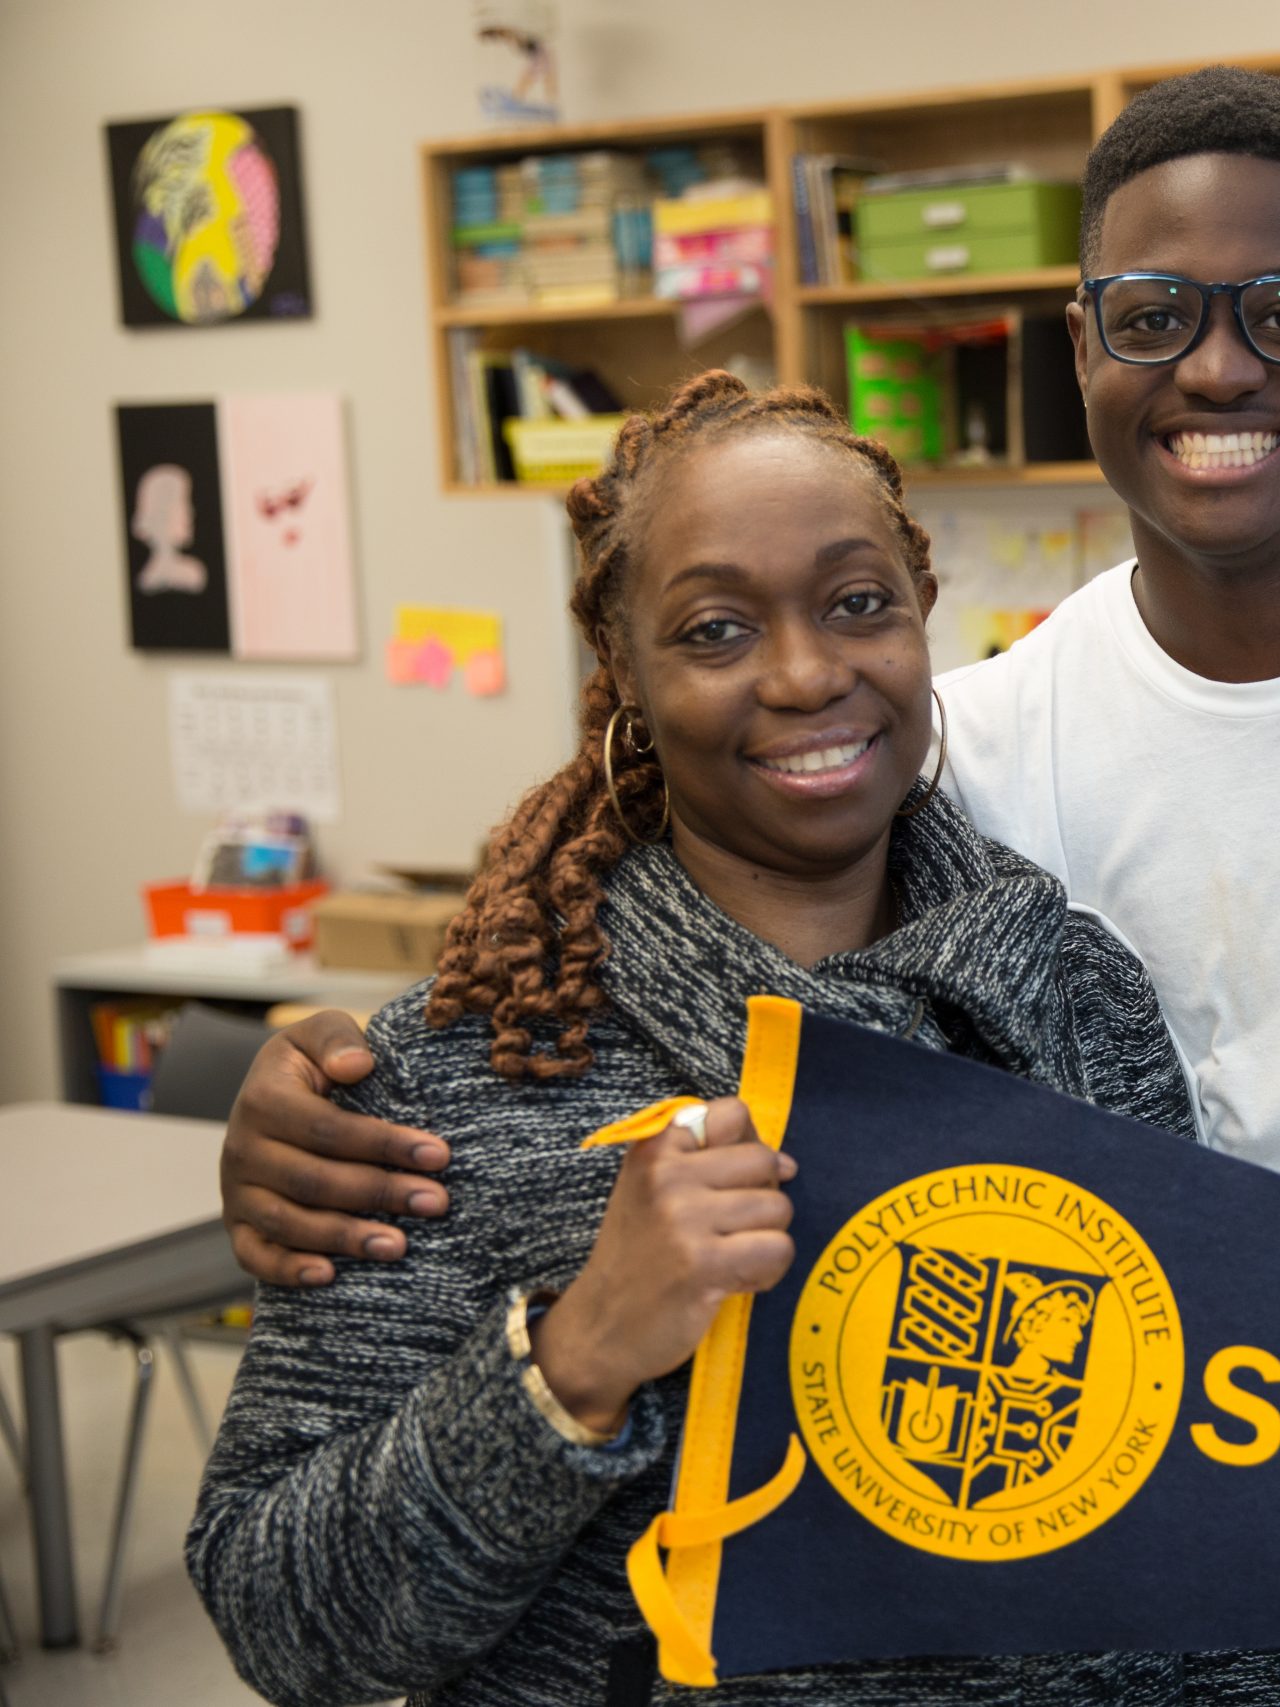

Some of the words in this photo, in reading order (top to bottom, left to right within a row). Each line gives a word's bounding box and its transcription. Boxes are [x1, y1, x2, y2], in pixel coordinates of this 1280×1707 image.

[818, 1175, 1047, 1295] POLYTECHNIC
[1055, 1194, 1171, 1345] INSTITUTE
[803, 1361, 839, 1444] STATE
[833, 1447, 978, 1545] UNIVERSITY
[989, 1521, 1027, 1547] OF
[1036, 1489, 1099, 1538] NEW
[1103, 1419, 1158, 1491] YORK
